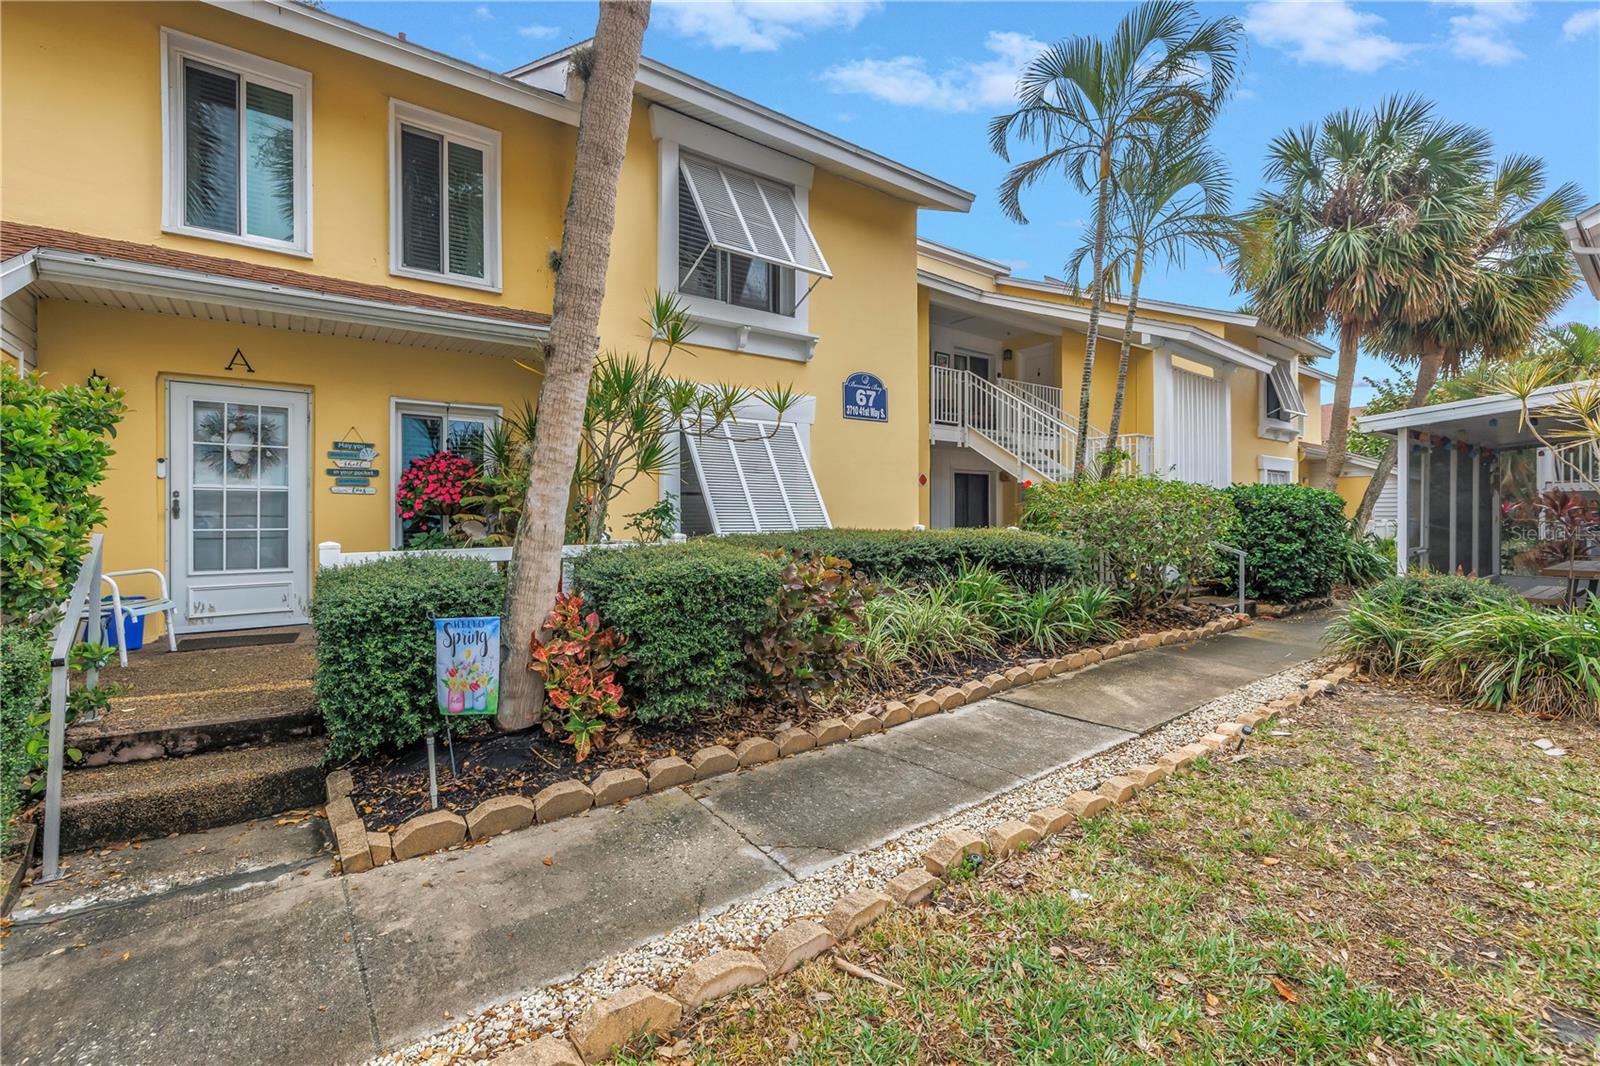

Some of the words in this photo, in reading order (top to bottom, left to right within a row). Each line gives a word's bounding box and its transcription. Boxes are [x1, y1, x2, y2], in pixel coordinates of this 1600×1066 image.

[224, 348, 255, 373] A
[856, 389, 876, 406] 67
[846, 404, 859, 415] 3710
[859, 406, 870, 416] 41st
[870, 407, 880, 419] Way
[443, 622, 488, 657] Spring
